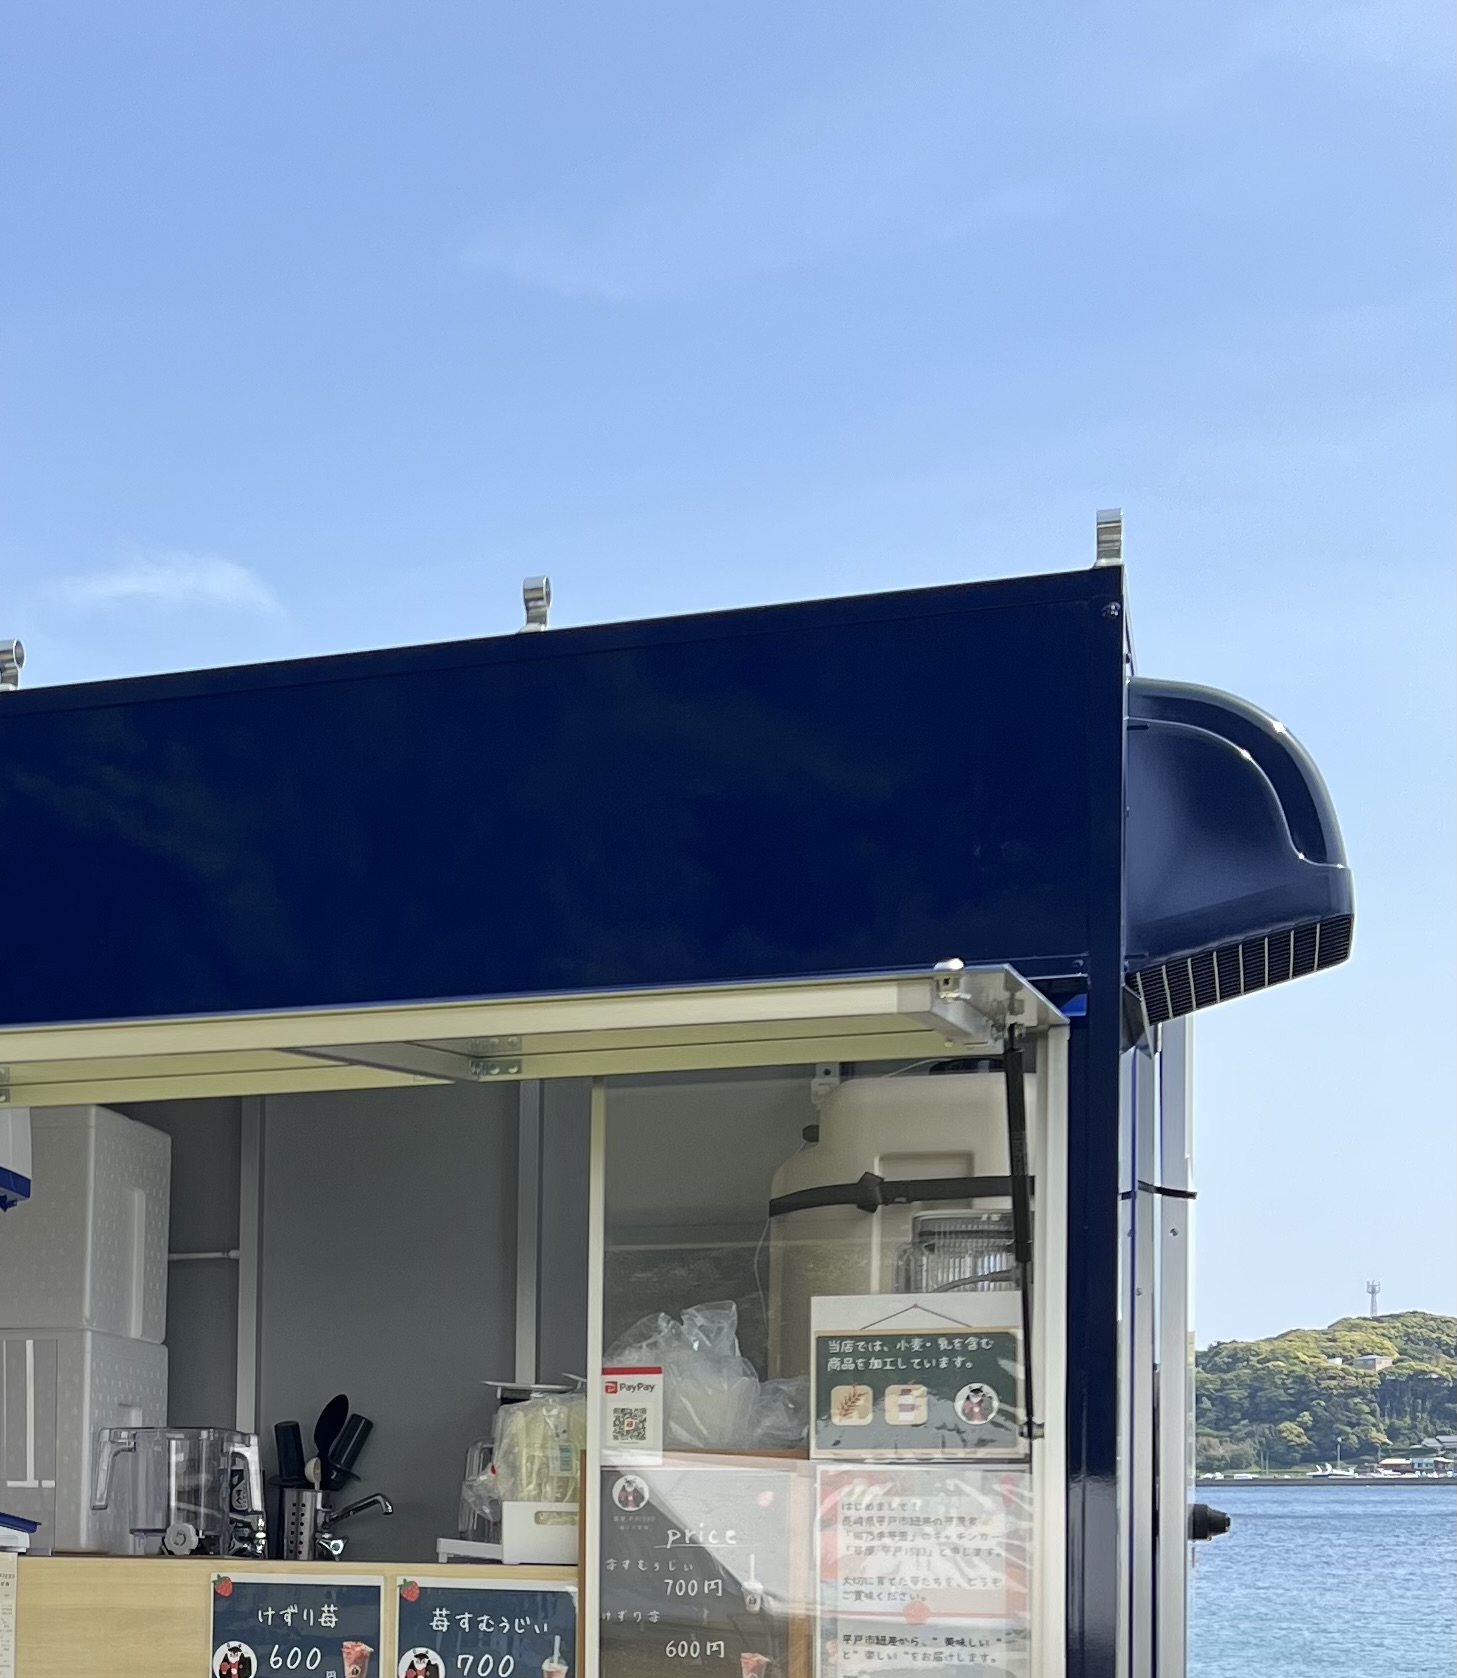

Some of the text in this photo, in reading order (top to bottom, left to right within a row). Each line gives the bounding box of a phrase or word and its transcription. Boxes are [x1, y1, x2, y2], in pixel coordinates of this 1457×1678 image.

[827, 1356, 974, 1371] 商品を加工しています。
[619, 1382, 655, 1393] PayPay
[666, 1522, 737, 1549] price
[664, 1579, 723, 1597] 700円
[257, 1604, 339, 1629] けずり苺
[665, 1640, 725, 1658] 600円
